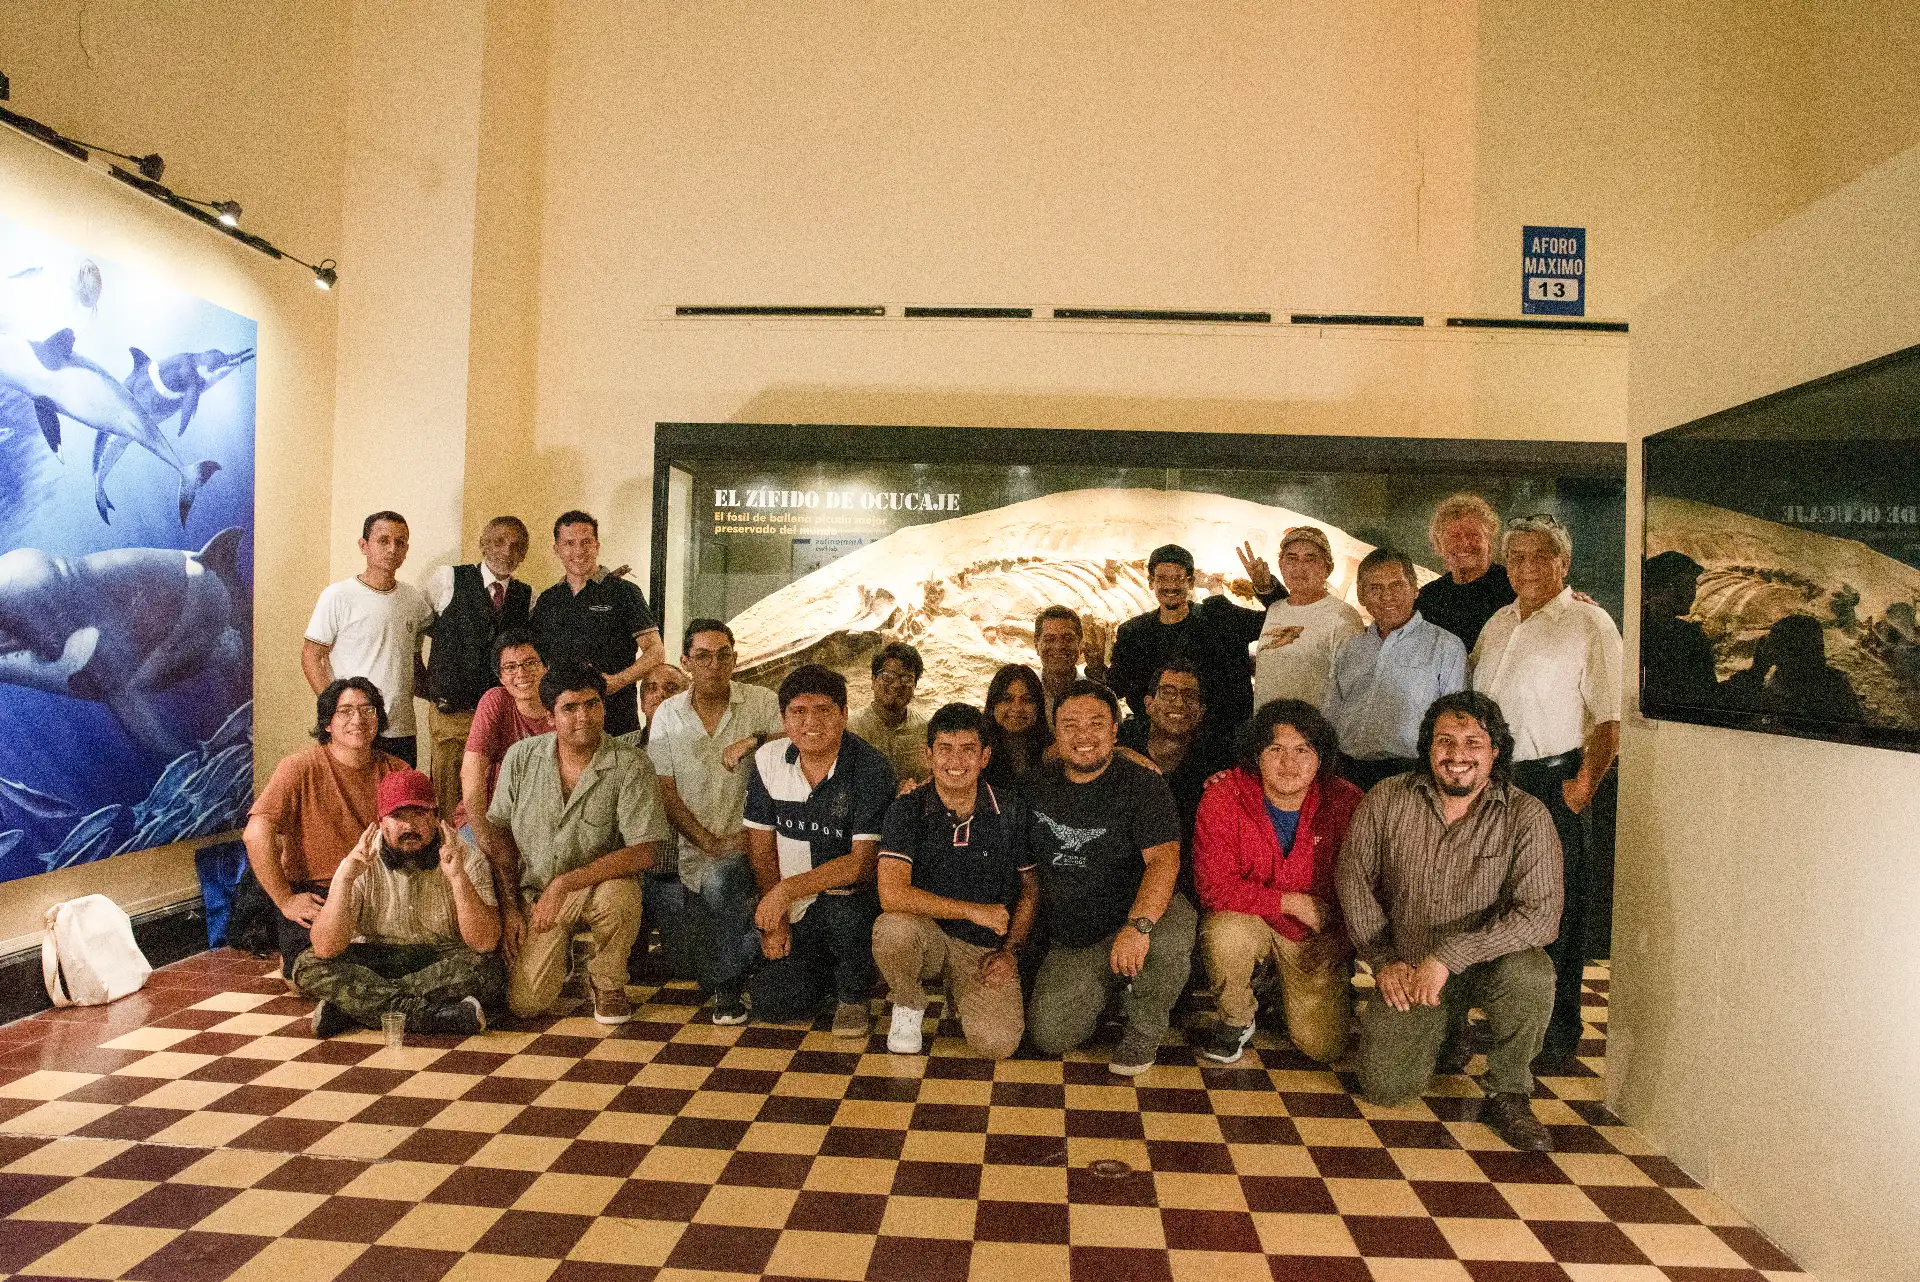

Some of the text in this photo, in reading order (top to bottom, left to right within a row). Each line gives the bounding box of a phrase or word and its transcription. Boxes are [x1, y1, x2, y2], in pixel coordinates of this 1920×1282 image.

[1531, 236, 1577, 254] AFORO
[1525, 256, 1583, 275] MAXIMO
[1538, 281, 1566, 297] 13
[714, 485, 960, 511] EL ZÍFIDO DE OCUCAJE
[714, 511, 887, 526] El fósil de ballena picuda mejor
[714, 525, 838, 536] preservado del mundo
[777, 815, 843, 838] LONDON
